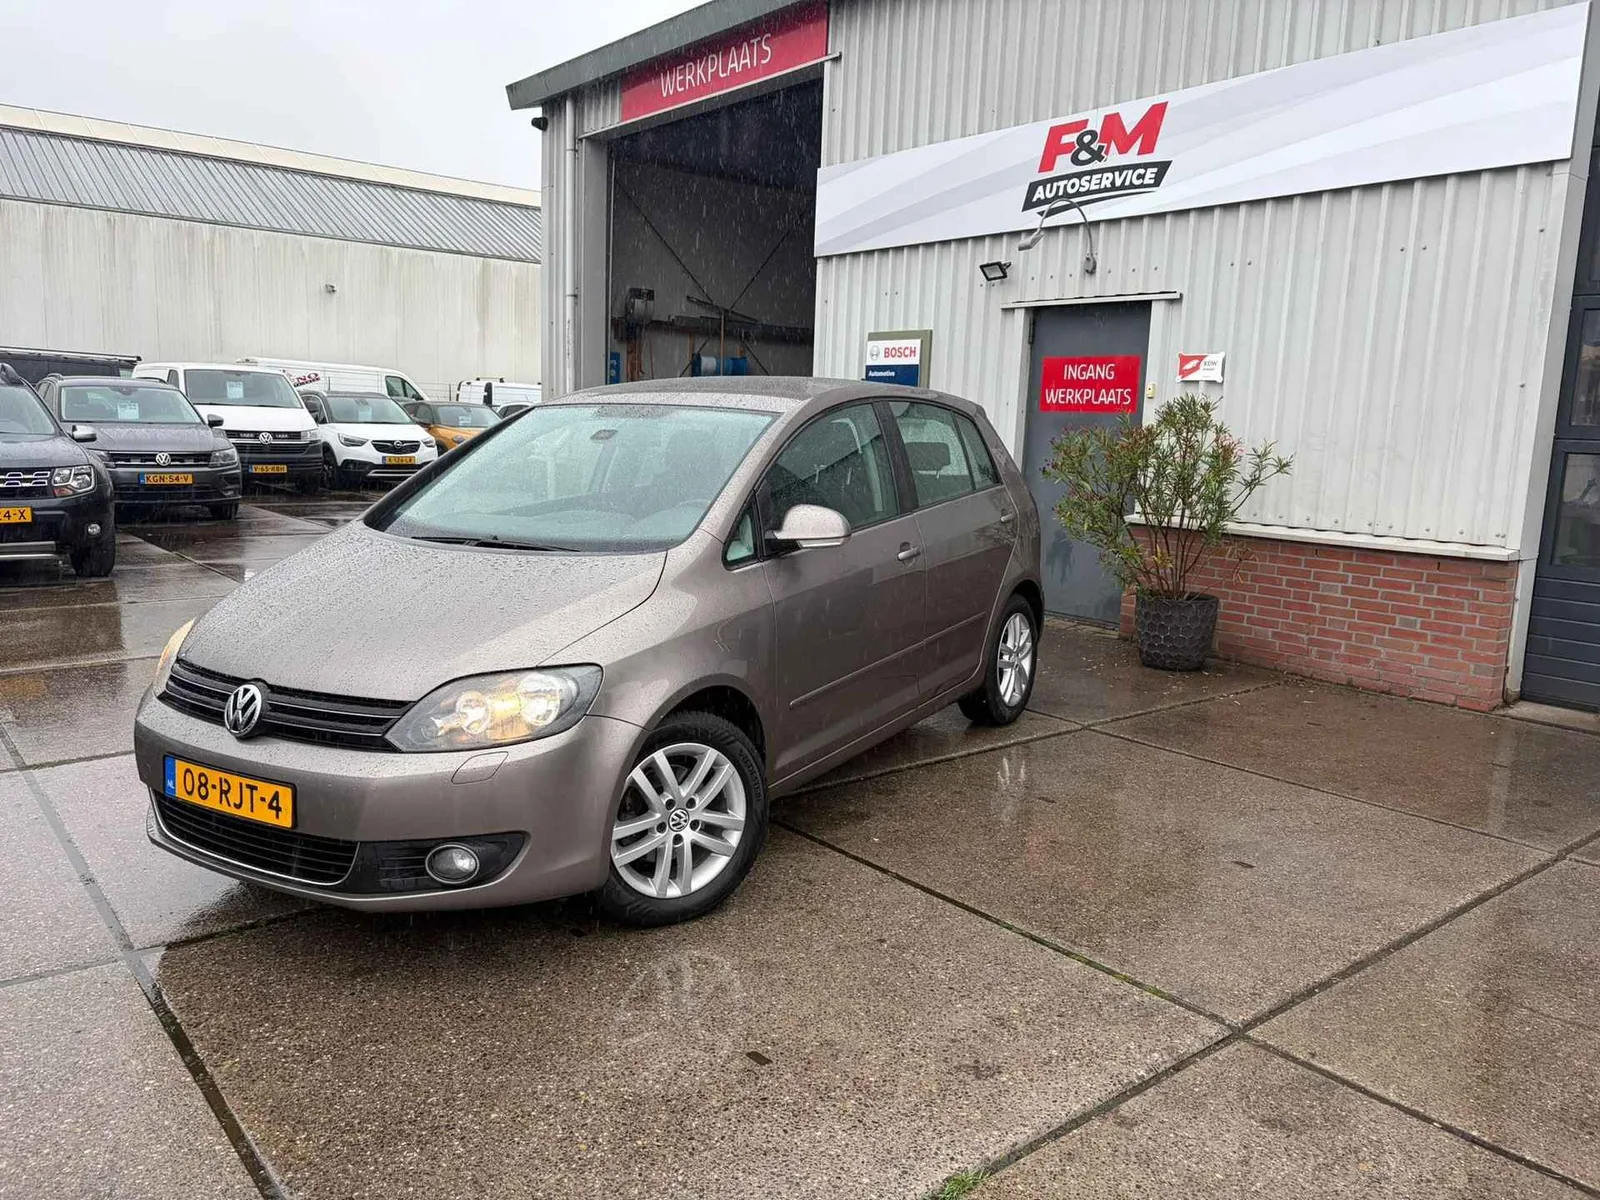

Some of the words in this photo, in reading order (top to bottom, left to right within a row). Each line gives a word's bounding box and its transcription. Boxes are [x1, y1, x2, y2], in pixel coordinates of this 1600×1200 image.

[661, 33, 772, 98] WERKPLAATS
[1038, 101, 1169, 174] F&M
[1032, 168, 1158, 202] AUTOSERVICE
[884, 346, 917, 358] BOSCH
[1063, 363, 1116, 380] INGANG
[1045, 388, 1132, 405] WERKPLAATS
[146, 474, 190, 483] KGN-54-V
[0, 509, 27, 520] 4-X
[183, 767, 283, 820] 08-RJT-4
